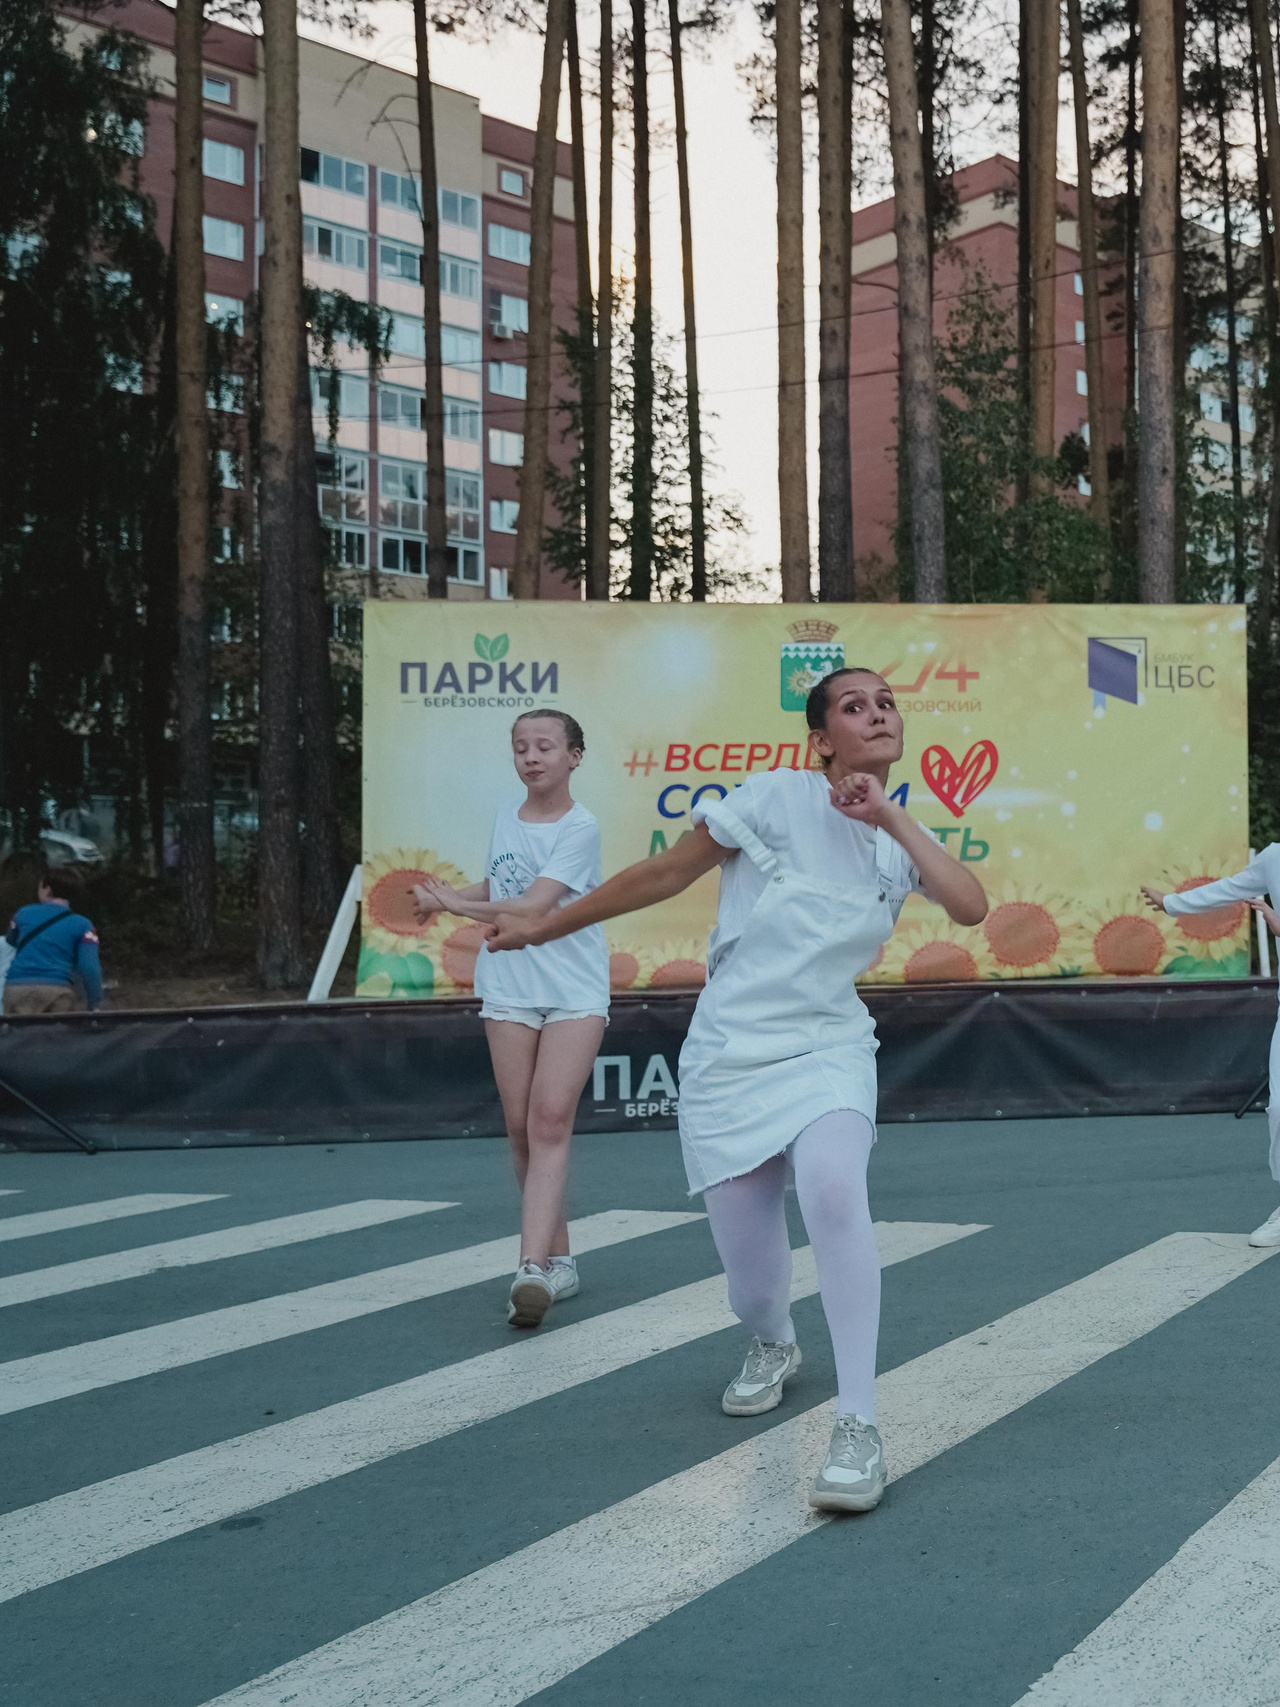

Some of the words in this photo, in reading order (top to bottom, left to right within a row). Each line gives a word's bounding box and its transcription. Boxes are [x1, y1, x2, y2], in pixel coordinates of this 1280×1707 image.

[400, 662, 559, 694] ПАРКИ
[1154, 665, 1216, 693] ЦБС
[424, 695, 535, 708] БЕРЁЗОВСКОГО
[593, 1053, 679, 1101] ПА
